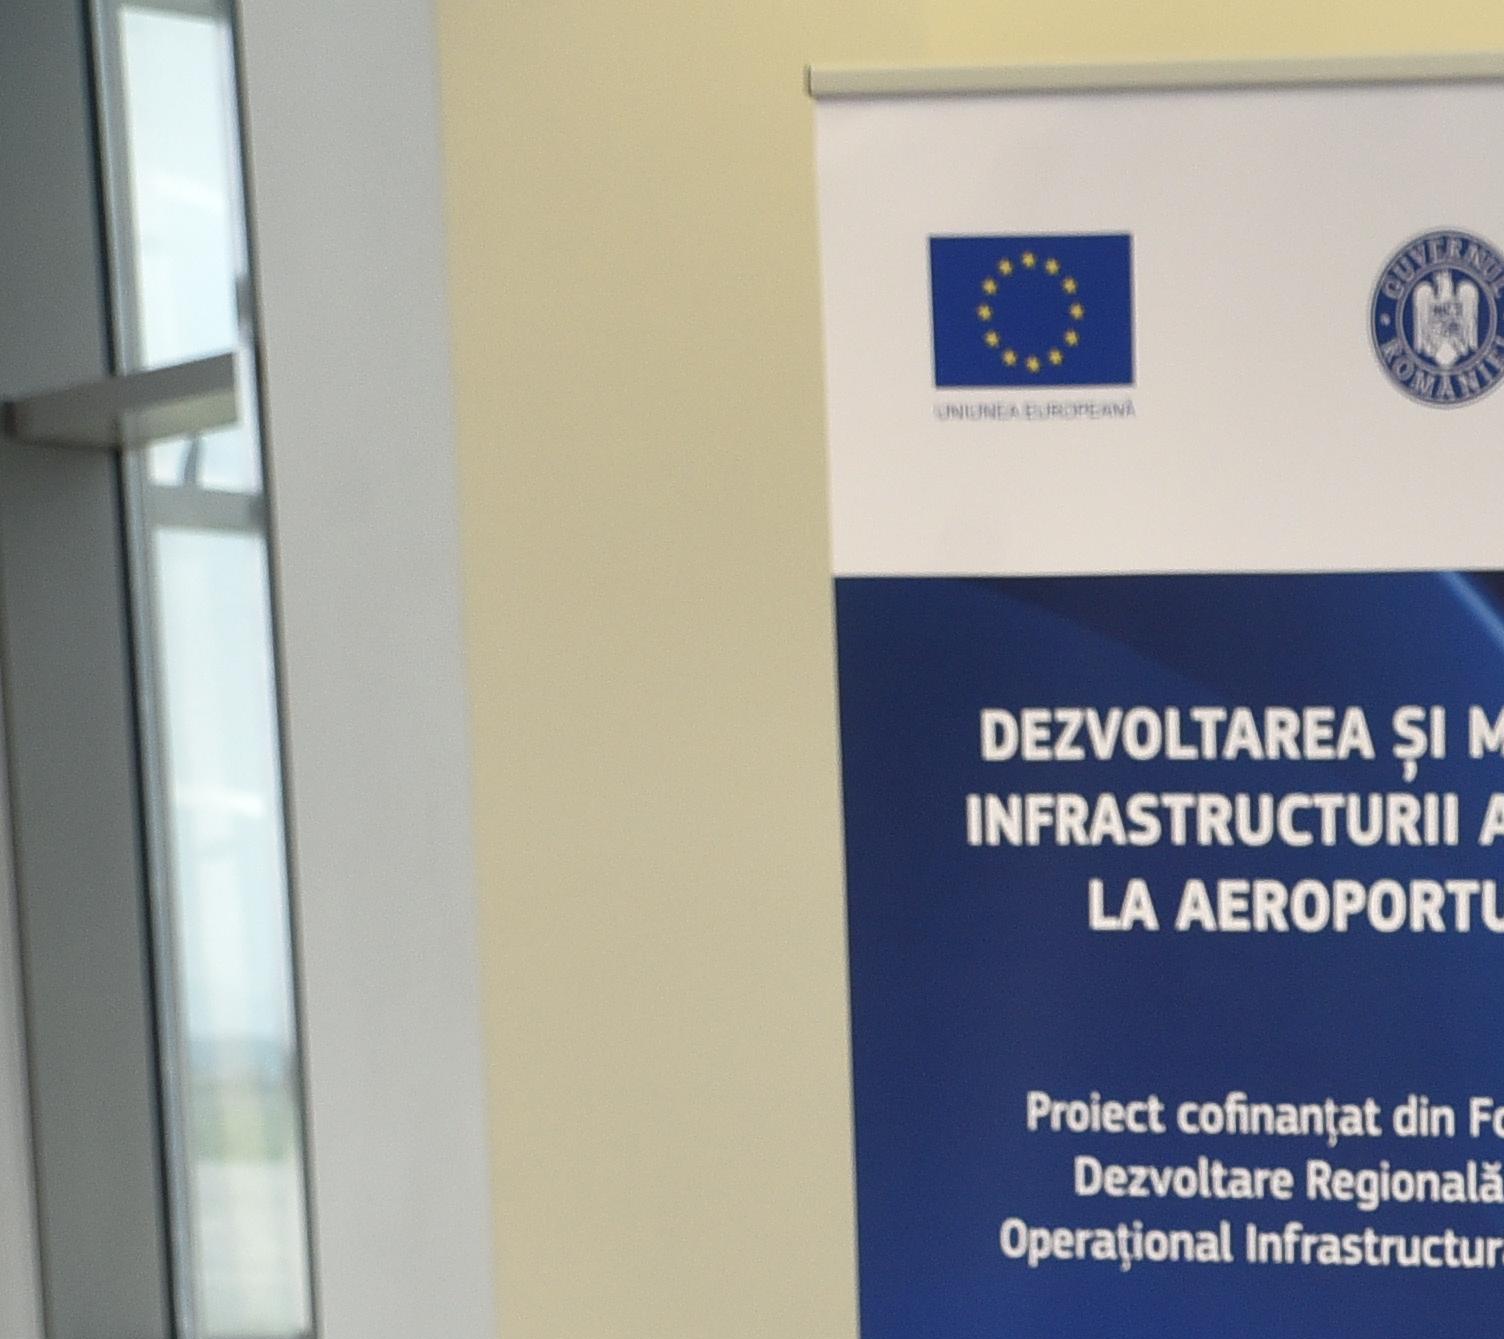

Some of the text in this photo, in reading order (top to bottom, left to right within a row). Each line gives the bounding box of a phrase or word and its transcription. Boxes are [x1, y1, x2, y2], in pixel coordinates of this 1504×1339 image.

[980, 706, 1375, 761] DEZVOLTAREA
[1392, 705, 1446, 783] ȘI
[966, 792, 1459, 847] INFRASTRUCTURII
[1088, 878, 1159, 931] LA
[1026, 1090, 1167, 1134] Proiect
[1176, 1091, 1383, 1148] cofinanțat
[1392, 1094, 1455, 1137] din
[1074, 1155, 1294, 1200] Dezvoltare
[999, 1217, 1234, 1272] Operațional
